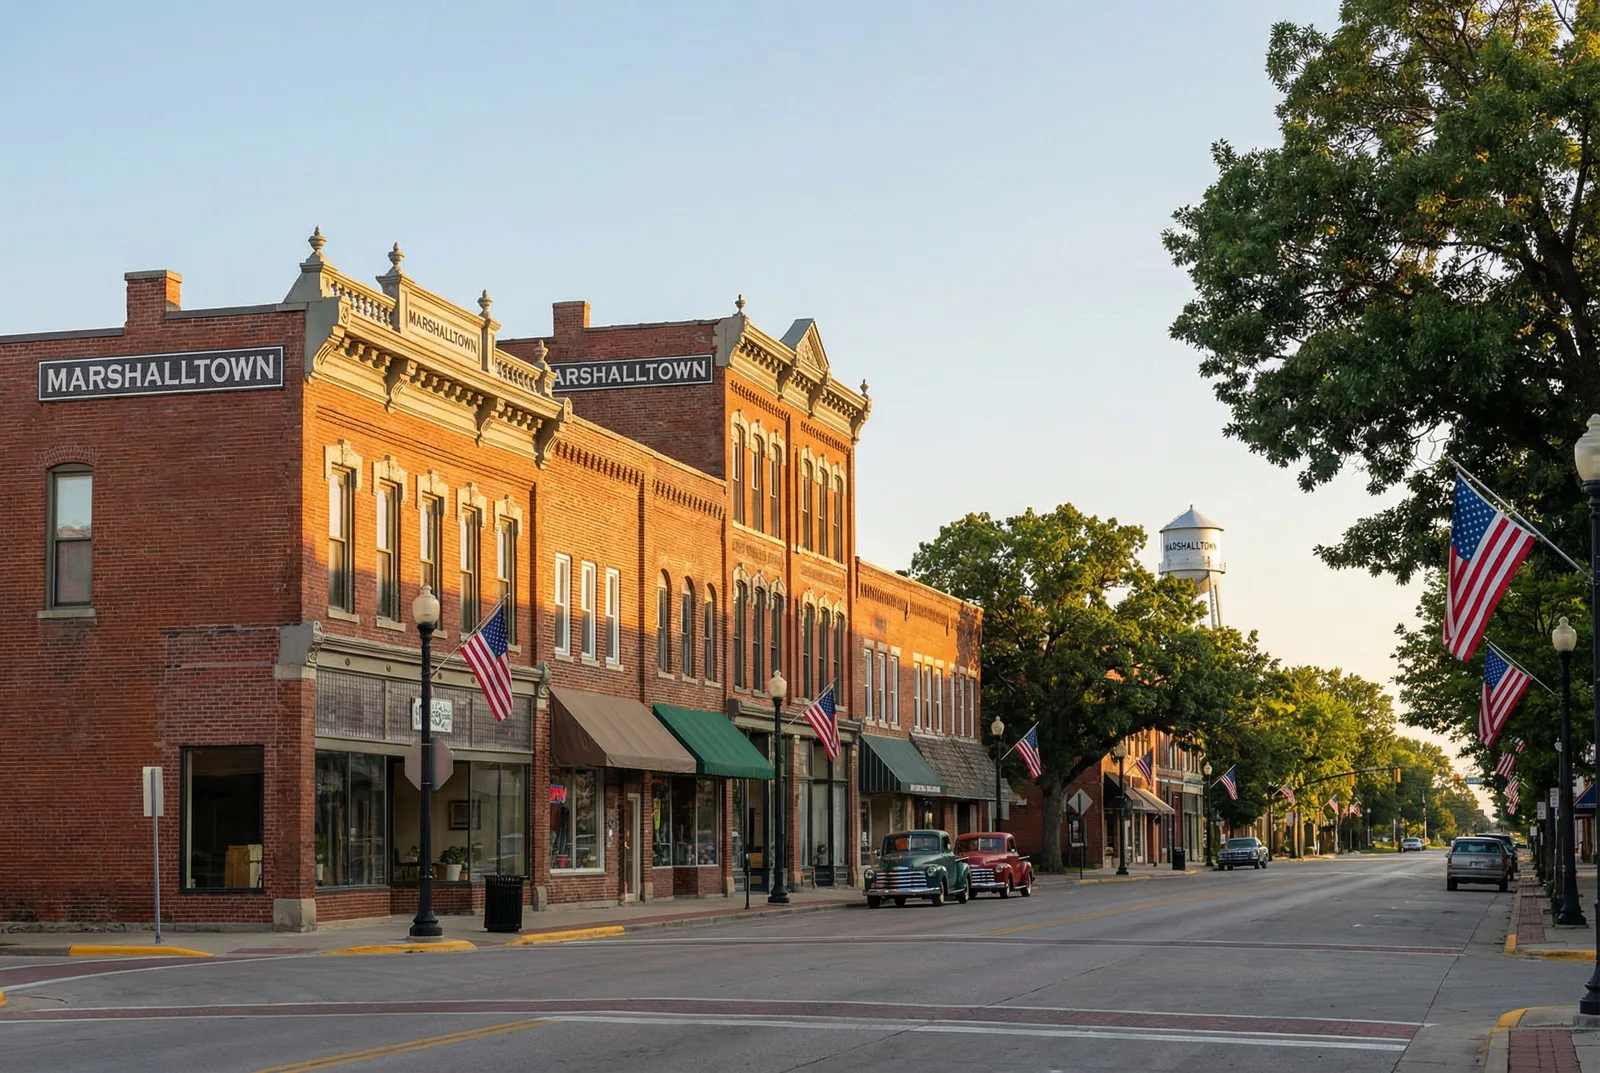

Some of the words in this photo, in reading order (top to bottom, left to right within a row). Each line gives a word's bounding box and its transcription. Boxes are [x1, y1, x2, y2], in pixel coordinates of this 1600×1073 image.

[409, 309, 477, 354] MARSHALLTOWN
[47, 354, 274, 393] MARSHALLTOWN
[552, 360, 706, 387] ARSHALLTOWN
